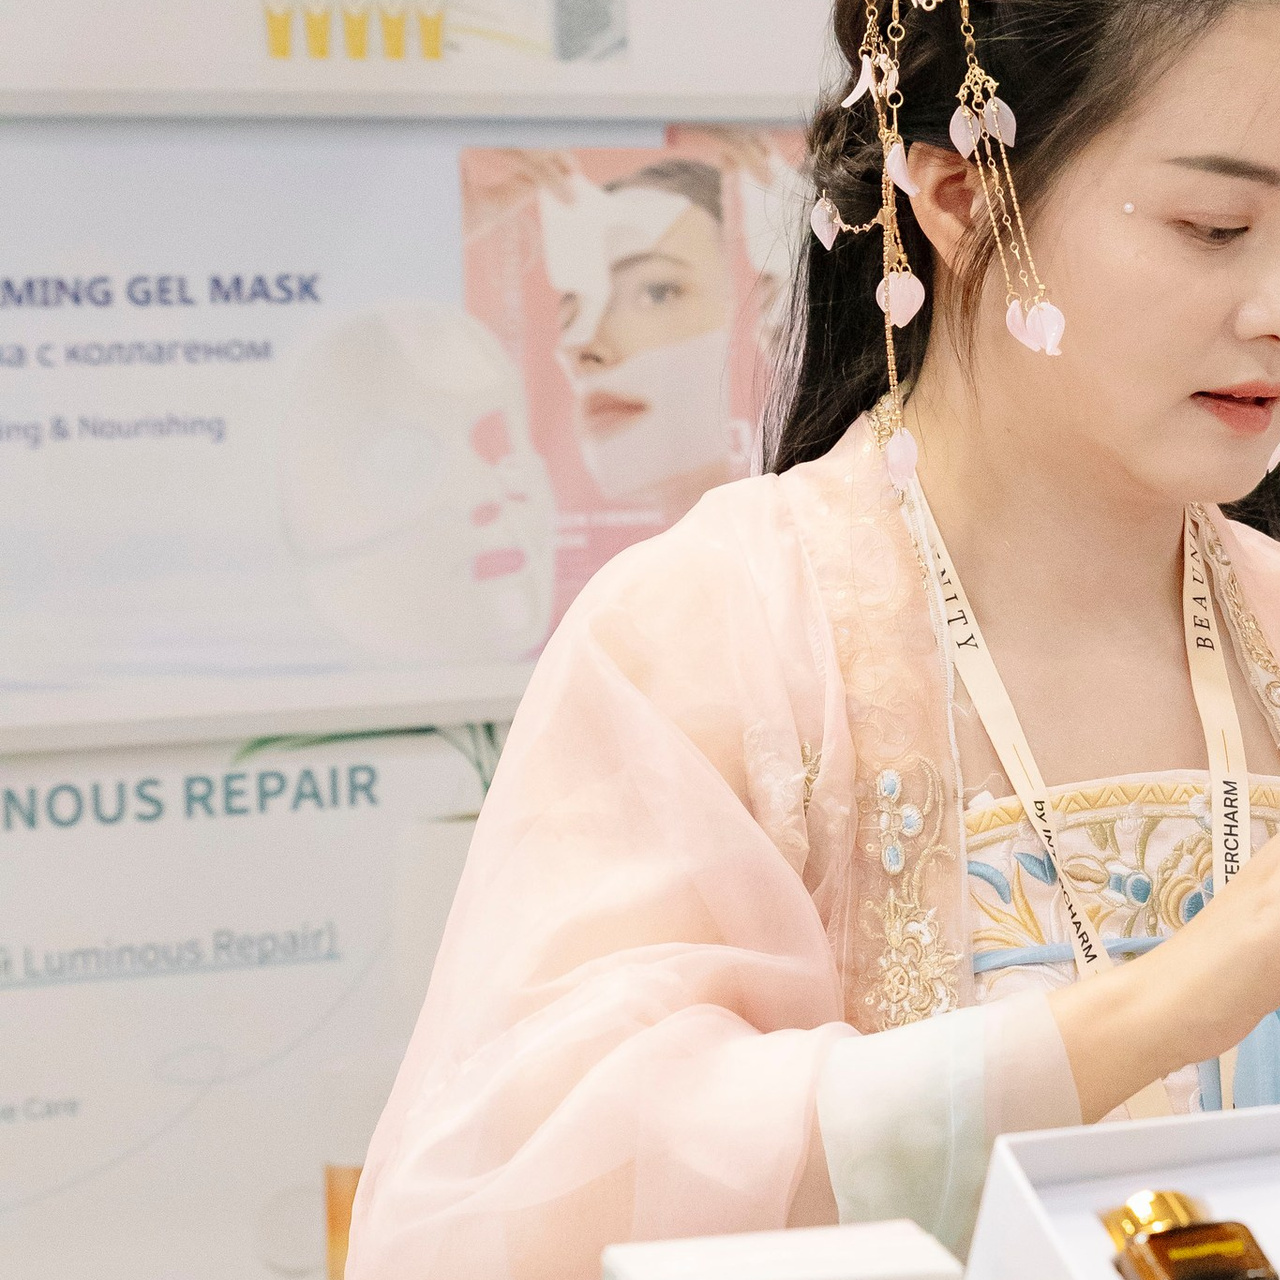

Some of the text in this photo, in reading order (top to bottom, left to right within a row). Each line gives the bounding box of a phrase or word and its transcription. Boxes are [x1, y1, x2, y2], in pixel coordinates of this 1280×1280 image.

[126, 274, 197, 307] GEL
[208, 272, 320, 305] MASK
[77, 412, 227, 445] Nourishing
[2, 763, 380, 832] NOUS REPAIR
[1034, 800, 1047, 824] by
[23, 937, 203, 980] Luminous
